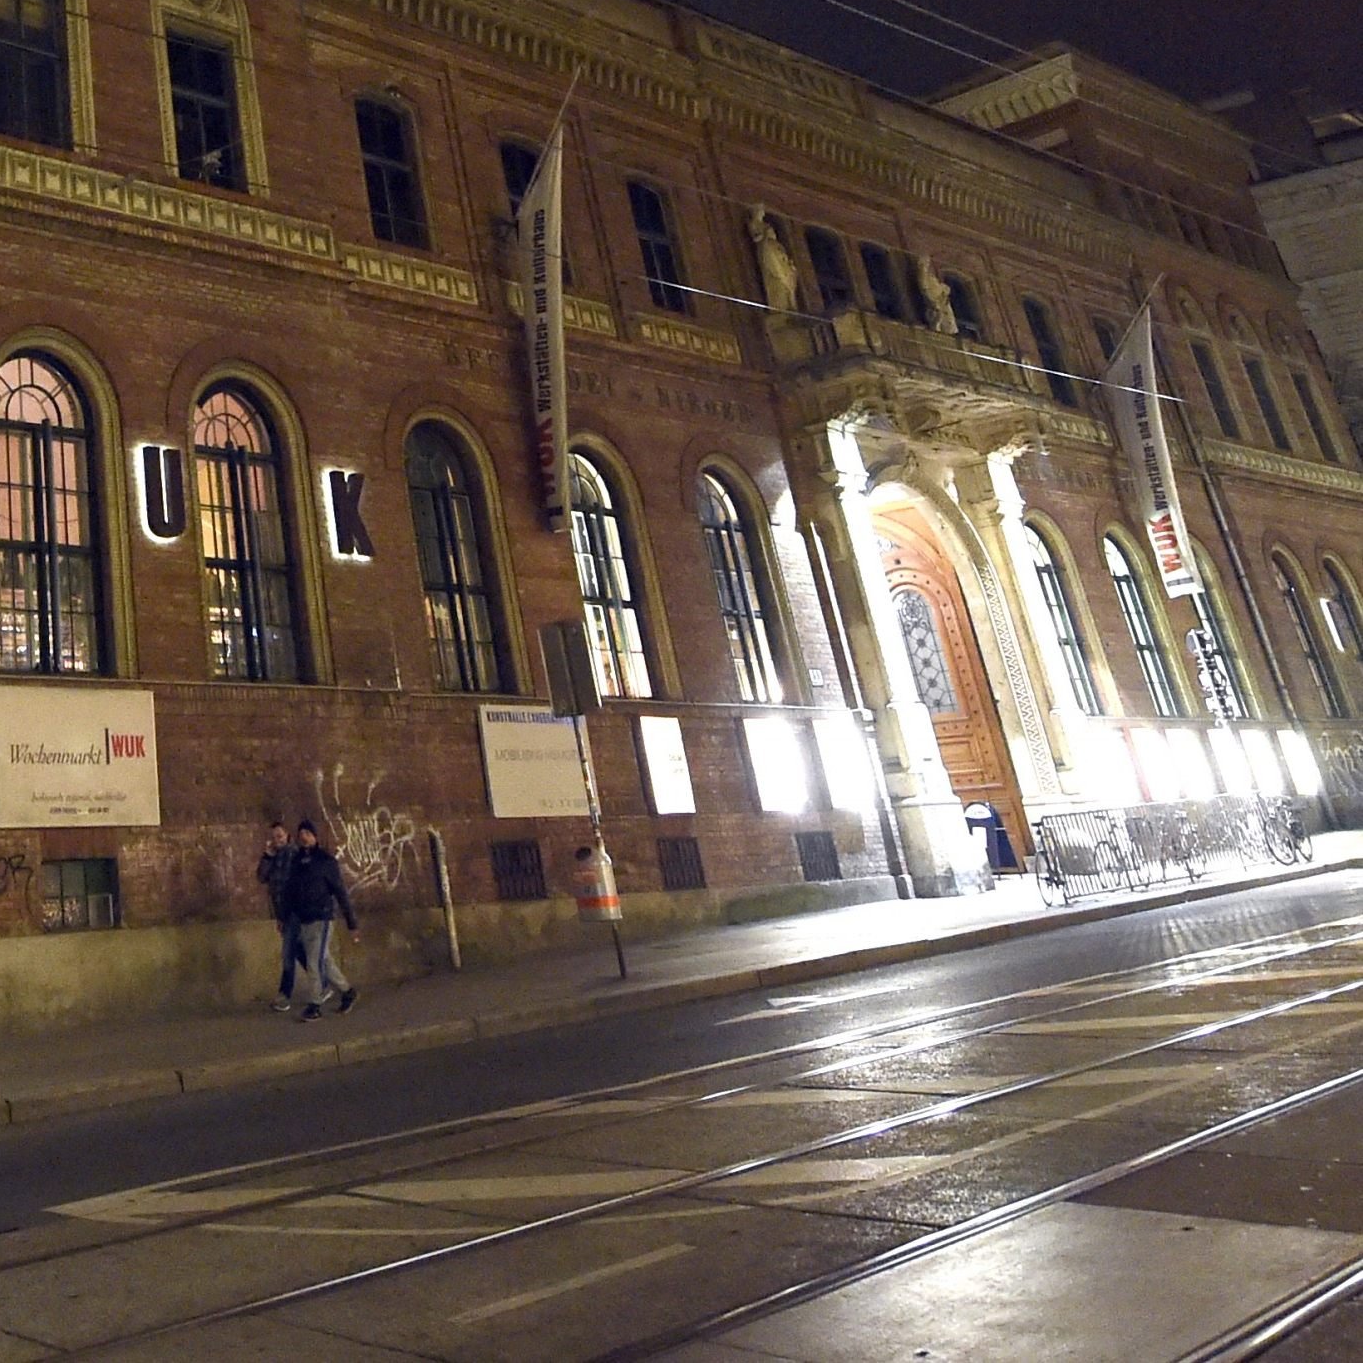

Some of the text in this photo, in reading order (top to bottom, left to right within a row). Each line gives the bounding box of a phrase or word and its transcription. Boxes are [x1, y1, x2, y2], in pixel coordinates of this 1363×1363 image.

[534, 289, 547, 314] und
[1149, 513, 1182, 574] WUK
[10, 743, 102, 765] Wochenmarkt
[111, 735, 146, 758] WUK
